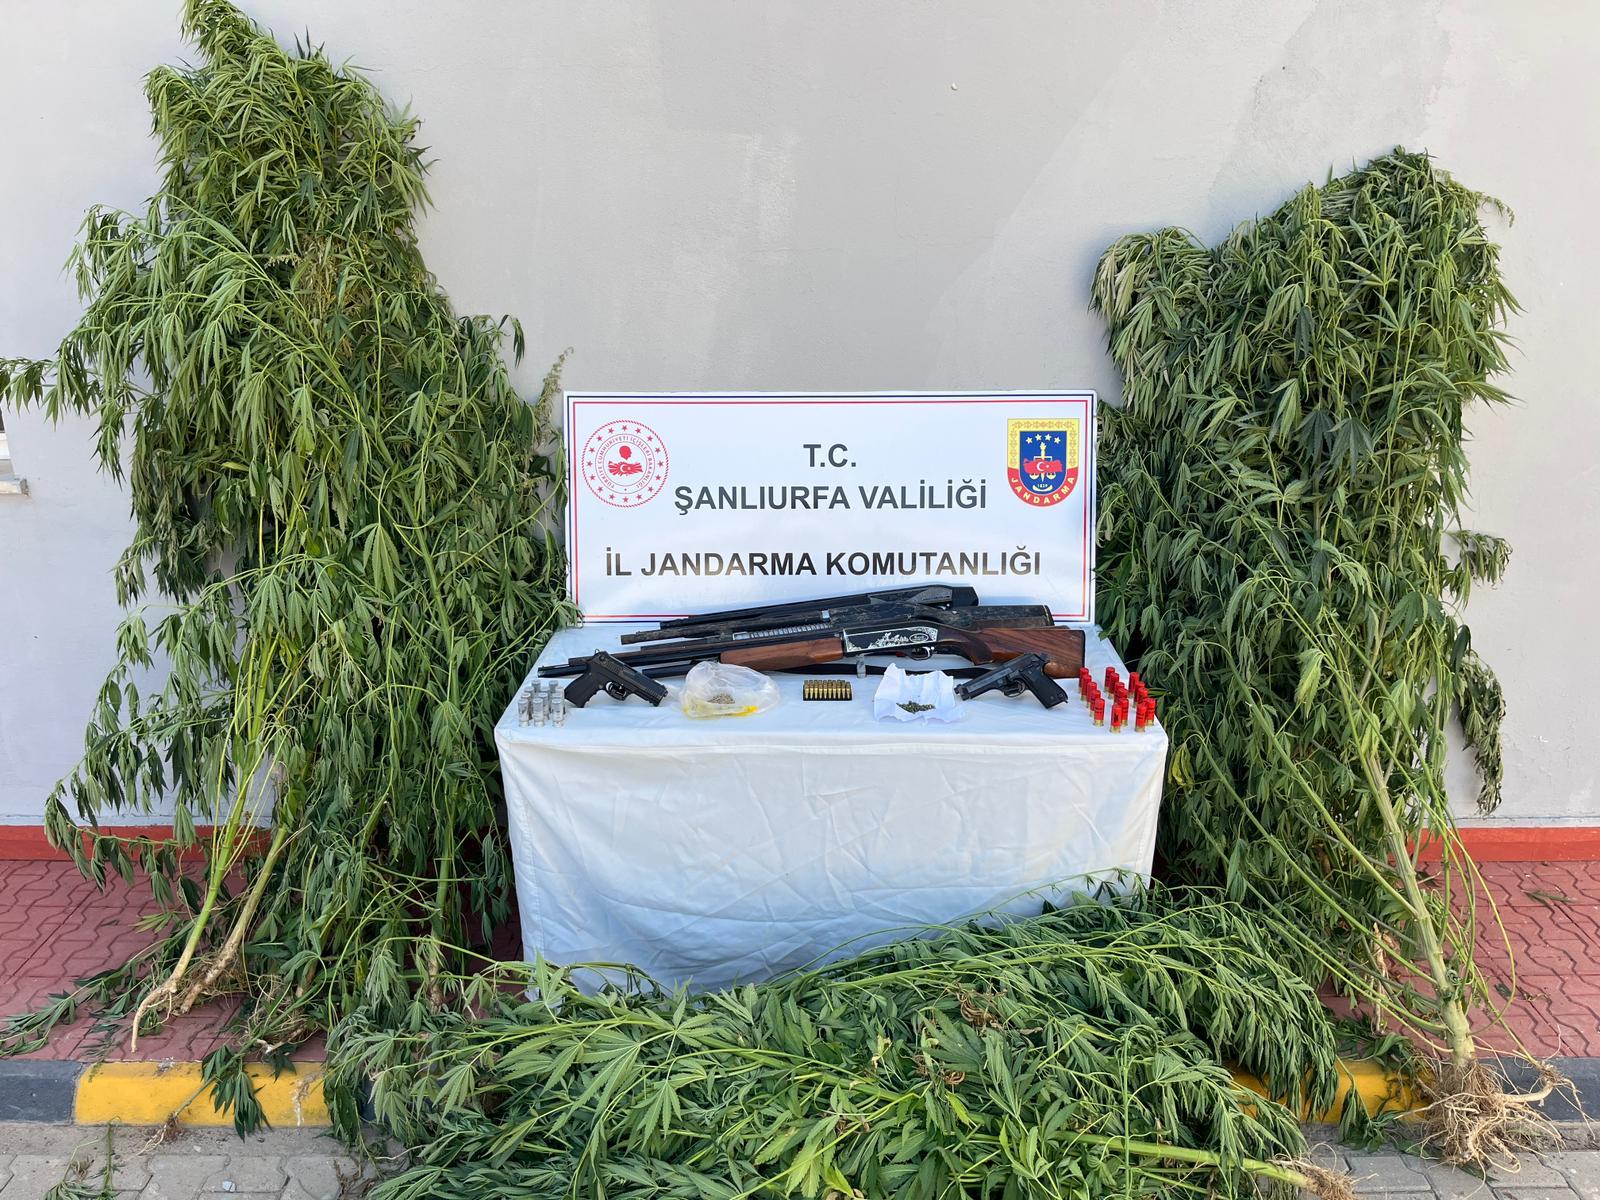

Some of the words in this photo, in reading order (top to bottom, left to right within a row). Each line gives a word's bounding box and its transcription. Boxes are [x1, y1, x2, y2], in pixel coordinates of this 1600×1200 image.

[802, 443, 857, 468] T.C.
[674, 485, 851, 516] ŞANLIURFA
[858, 478, 986, 509] VALİLİĞİ
[1011, 477, 1075, 504] JANDARMA
[606, 546, 632, 576] İL
[640, 552, 818, 576] JANDARMA
[826, 545, 1040, 576] KOMUTANLIĞI
